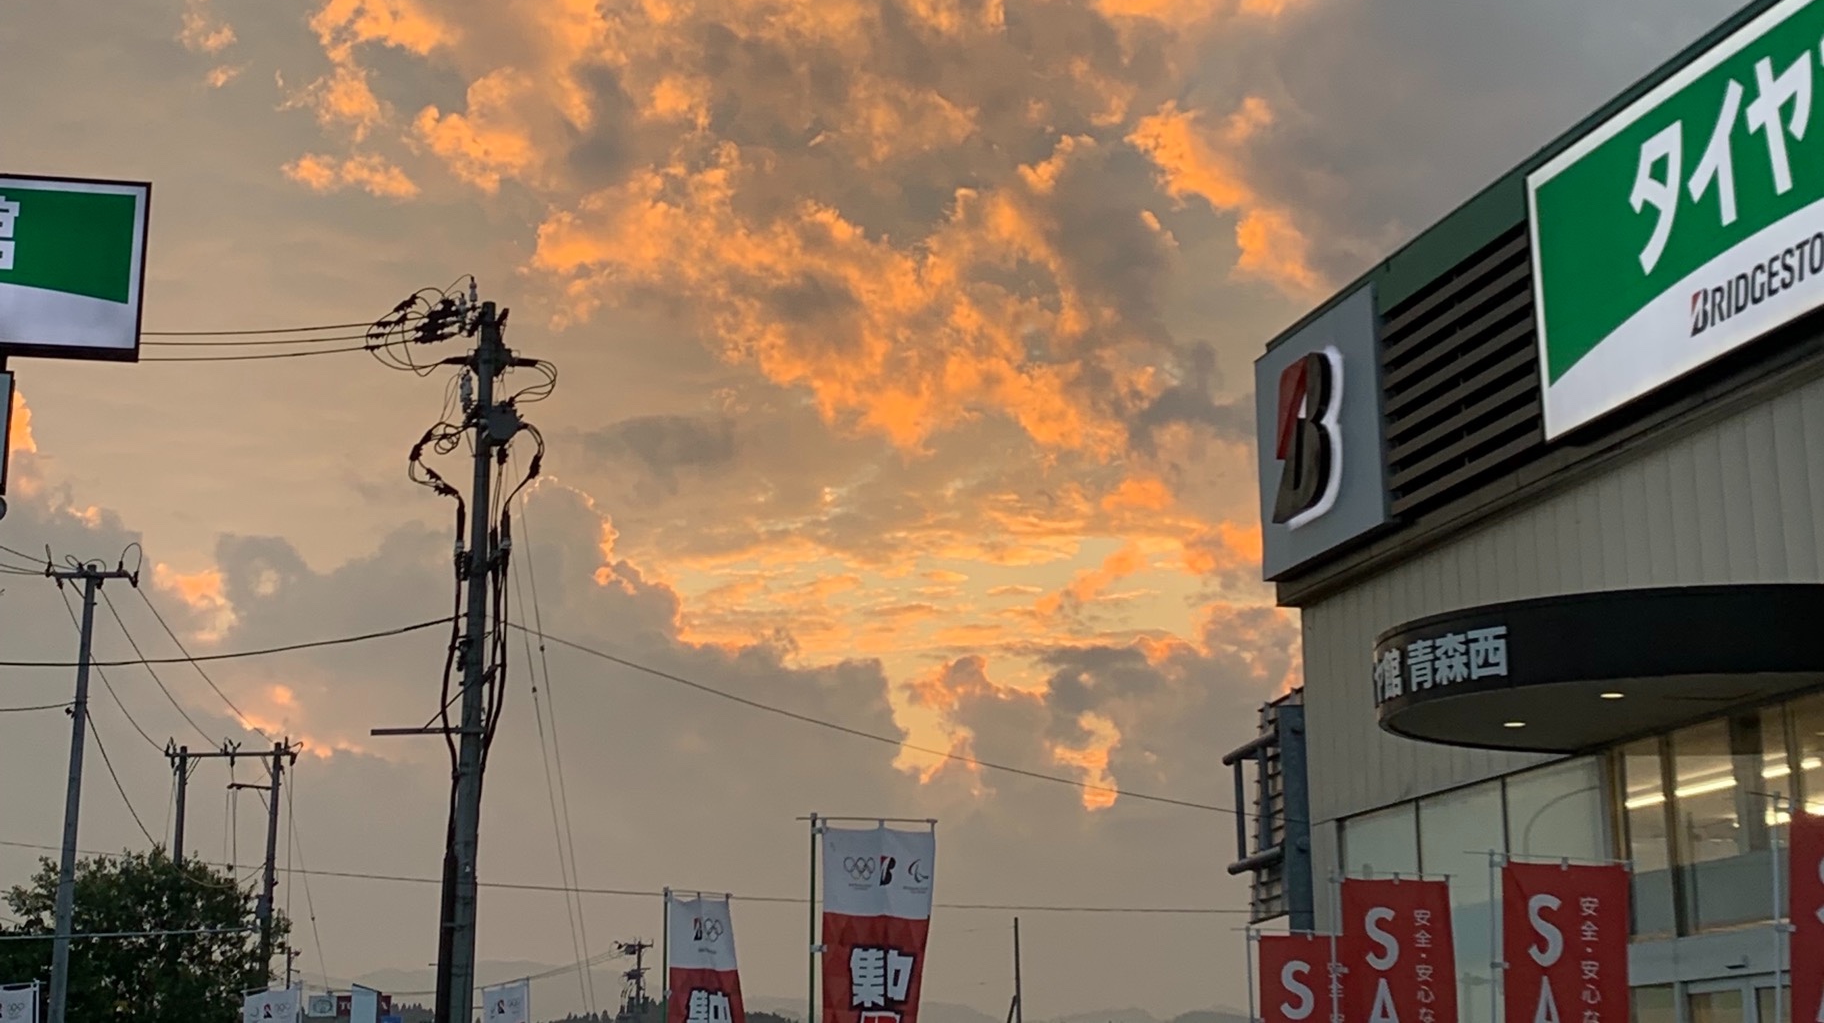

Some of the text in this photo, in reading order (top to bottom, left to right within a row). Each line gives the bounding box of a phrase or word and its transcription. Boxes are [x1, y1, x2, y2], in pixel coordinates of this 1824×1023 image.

[1629, 35, 1824, 277] タイヤ
[1690, 231, 1824, 338] BRIDGESTO
[1407, 626, 1508, 692] 青森西
